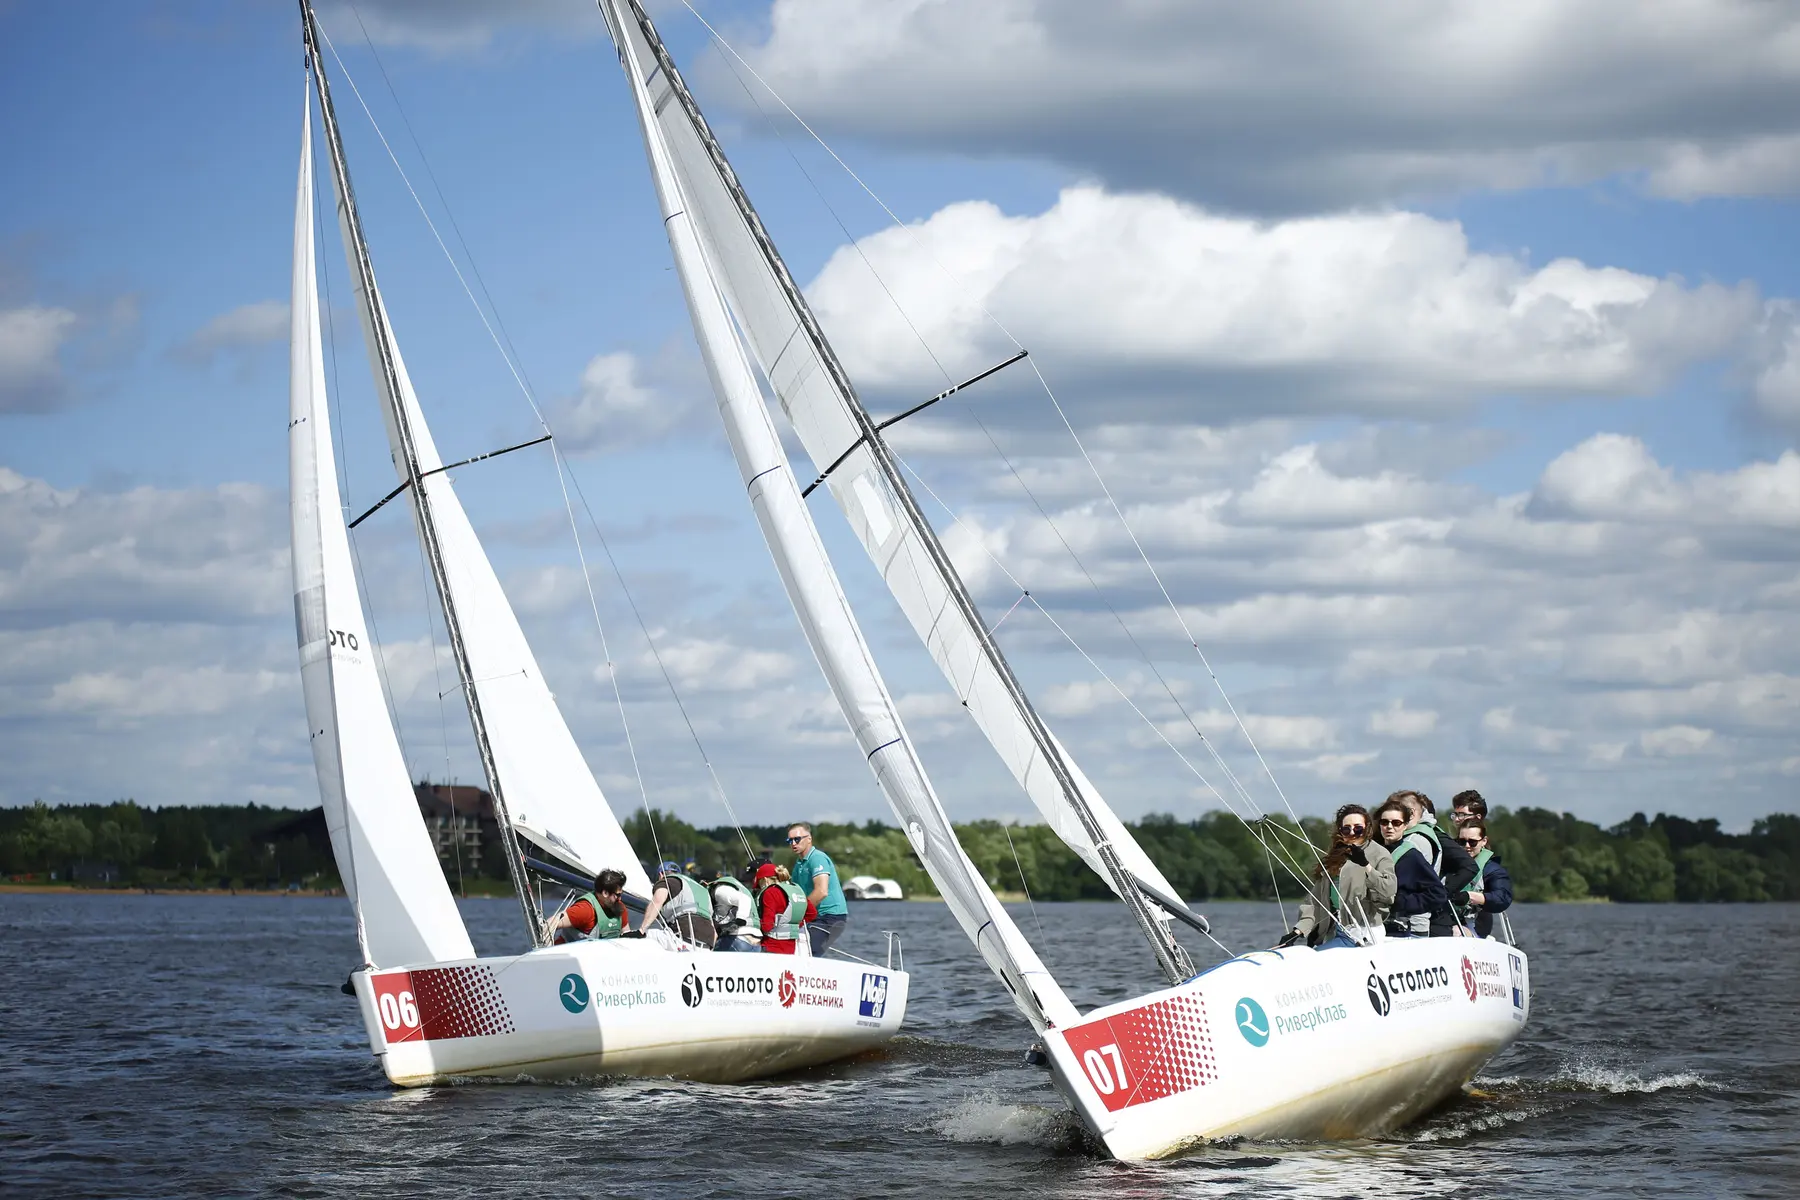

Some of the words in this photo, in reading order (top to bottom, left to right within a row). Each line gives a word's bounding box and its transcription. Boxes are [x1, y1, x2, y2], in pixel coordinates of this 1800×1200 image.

[1474, 961, 1500, 977] РУССКАЯ
[601, 973, 658, 987] КОНАКОВО
[705, 976, 773, 994] СТОЛОТО
[799, 975, 838, 991] РУССКАЯ
[1388, 966, 1448, 994] СТОЛОТО
[596, 990, 666, 1009] РиверКлаб
[799, 993, 844, 1008] МЕХАНИКА
[1274, 982, 1334, 1008] КОНАКОВО
[380, 991, 418, 1030] 06
[1275, 1003, 1347, 1035] РиверКлаб
[1083, 1043, 1128, 1095] 07
